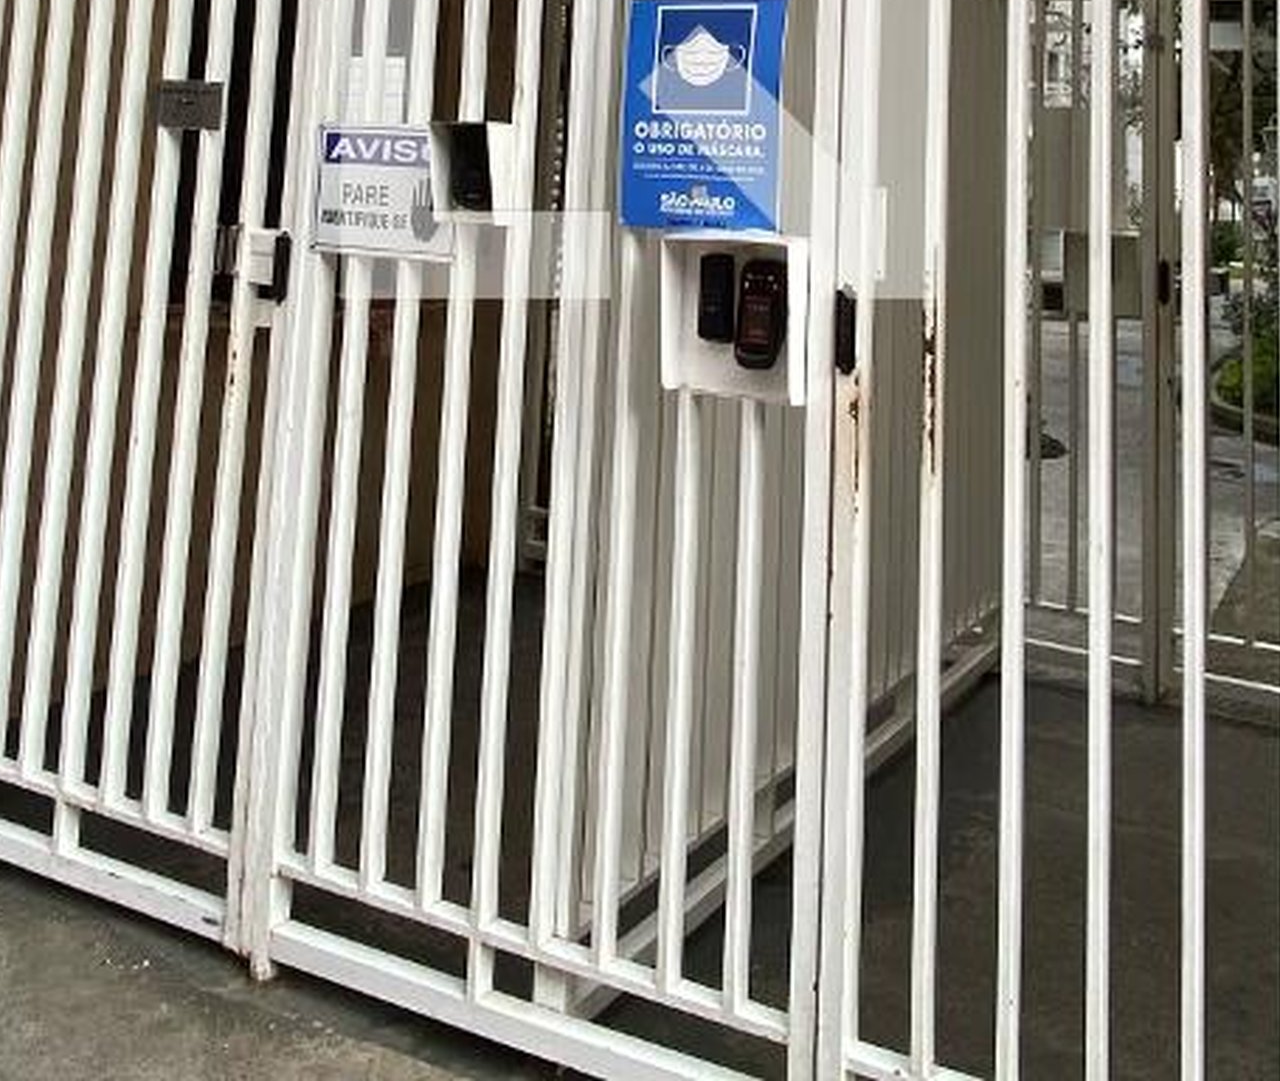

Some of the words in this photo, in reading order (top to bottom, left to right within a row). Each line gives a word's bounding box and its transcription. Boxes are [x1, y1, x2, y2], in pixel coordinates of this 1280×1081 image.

[634, 119, 767, 140] OBRIGATÓRIO
[329, 136, 429, 162] AVIS
[648, 142, 675, 155] USO
[678, 142, 695, 156] DE
[342, 183, 389, 207] PARE
